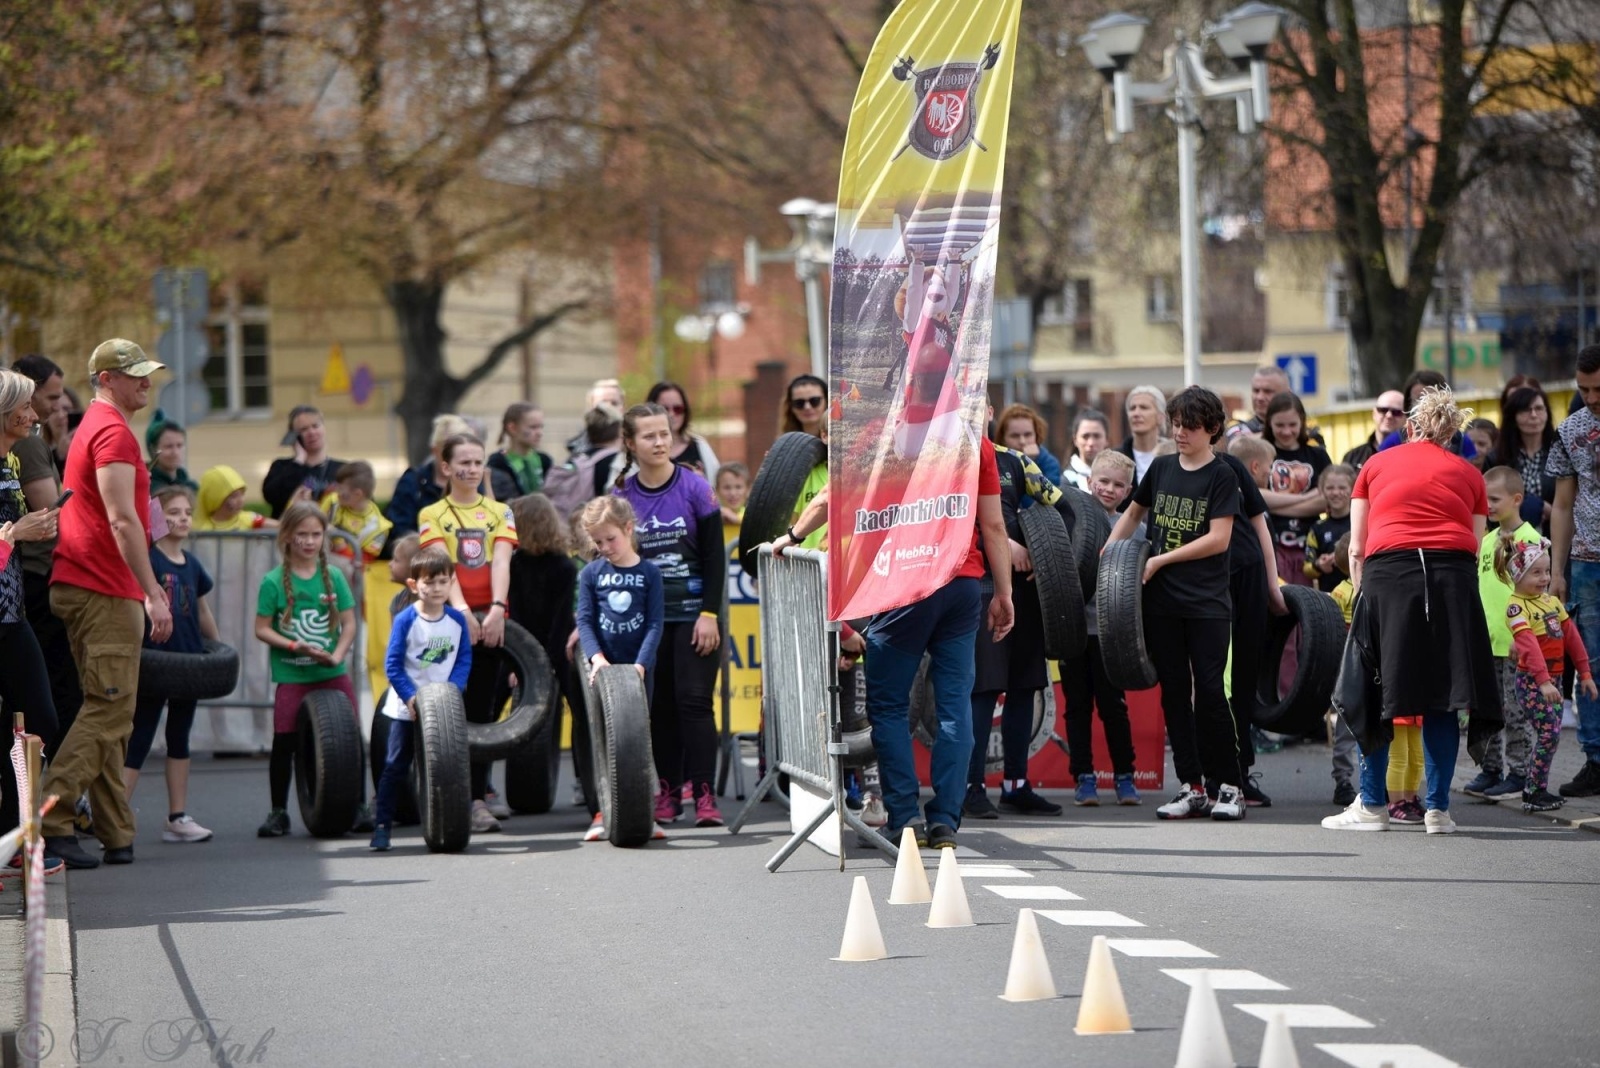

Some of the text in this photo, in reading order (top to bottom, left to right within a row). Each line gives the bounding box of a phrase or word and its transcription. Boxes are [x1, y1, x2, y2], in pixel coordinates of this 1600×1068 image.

[855, 494, 969, 533] Raciborki OCR
[1154, 491, 1208, 521] PURE
[1155, 514, 1200, 531] MINDSET
[895, 543, 939, 561] MebRaj
[598, 573, 645, 587] MORE
[599, 612, 644, 634] SELFIES
